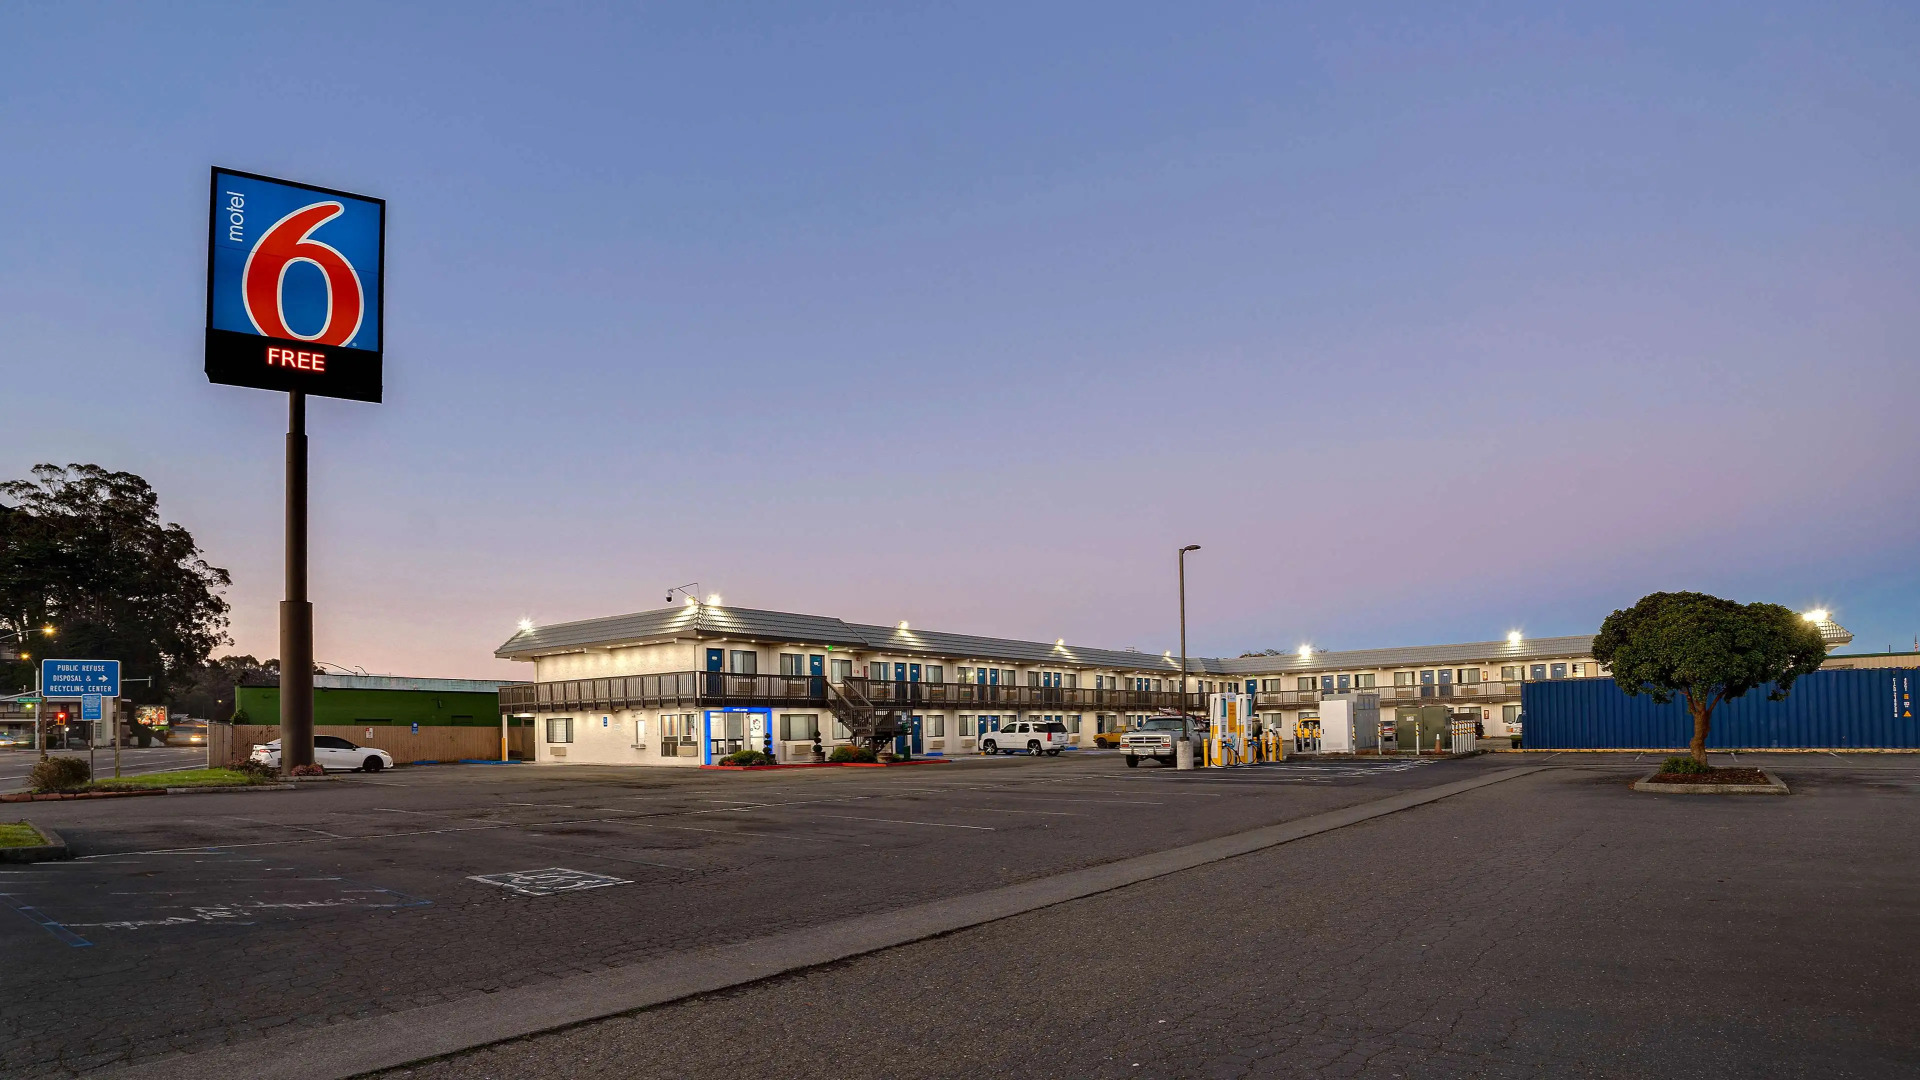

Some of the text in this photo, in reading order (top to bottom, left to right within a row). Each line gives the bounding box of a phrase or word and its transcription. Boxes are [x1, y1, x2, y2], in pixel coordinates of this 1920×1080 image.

[226, 190, 245, 242] motel
[242, 200, 364, 348] 6
[267, 347, 326, 372] FREE
[52, 674, 82, 682] DISPOSAL
[57, 664, 105, 672] PUBLIC REFUSE
